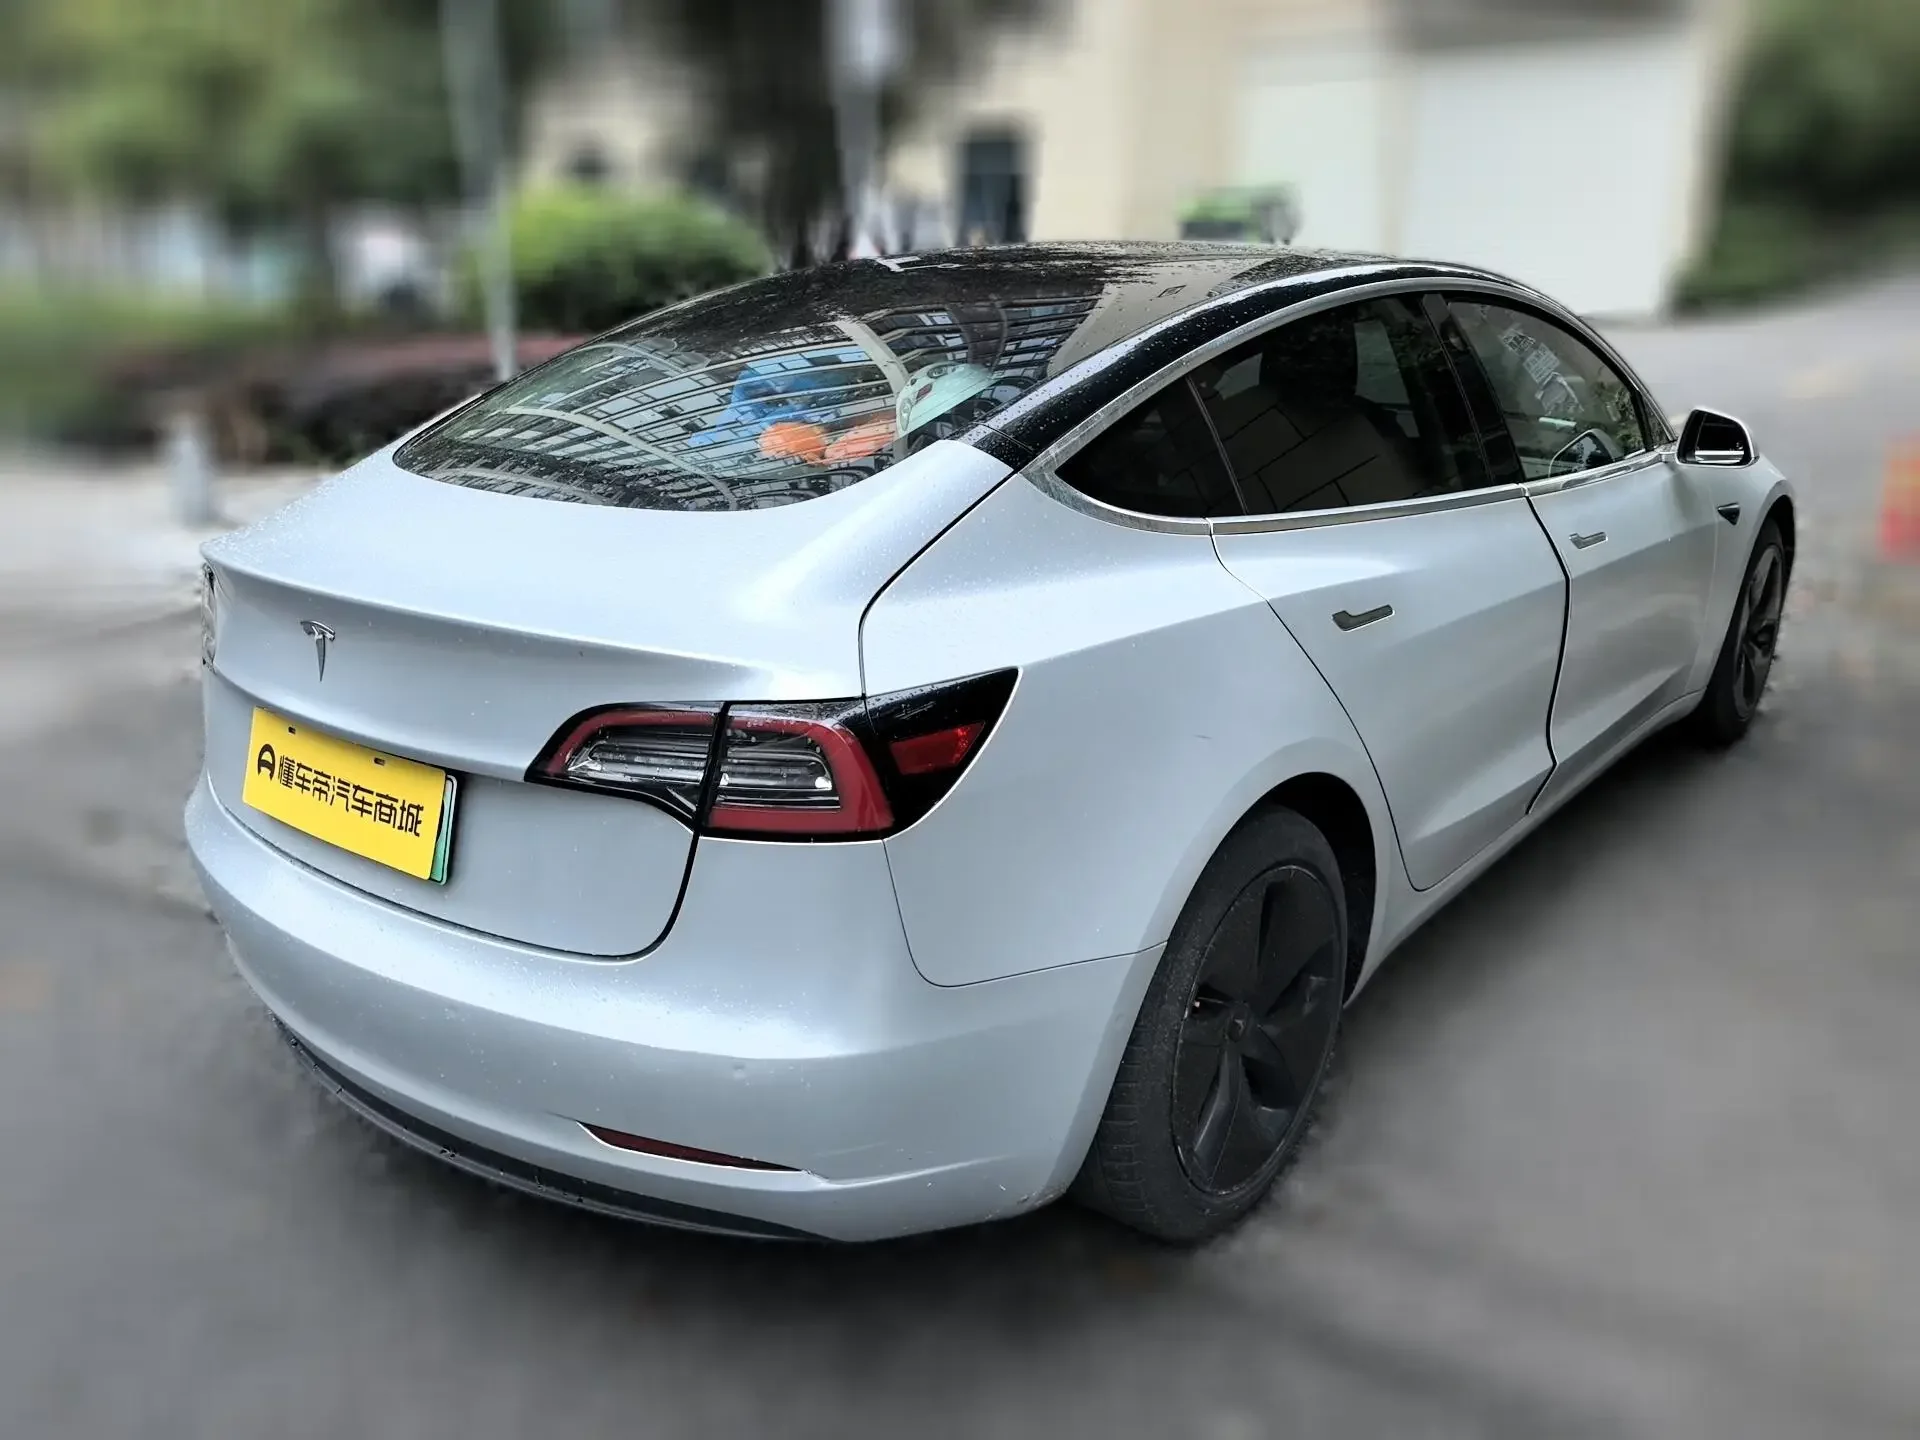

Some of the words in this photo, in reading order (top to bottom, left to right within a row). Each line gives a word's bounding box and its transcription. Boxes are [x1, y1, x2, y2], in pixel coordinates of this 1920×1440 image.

[278, 755, 424, 837] 懂车帝汽车商城
